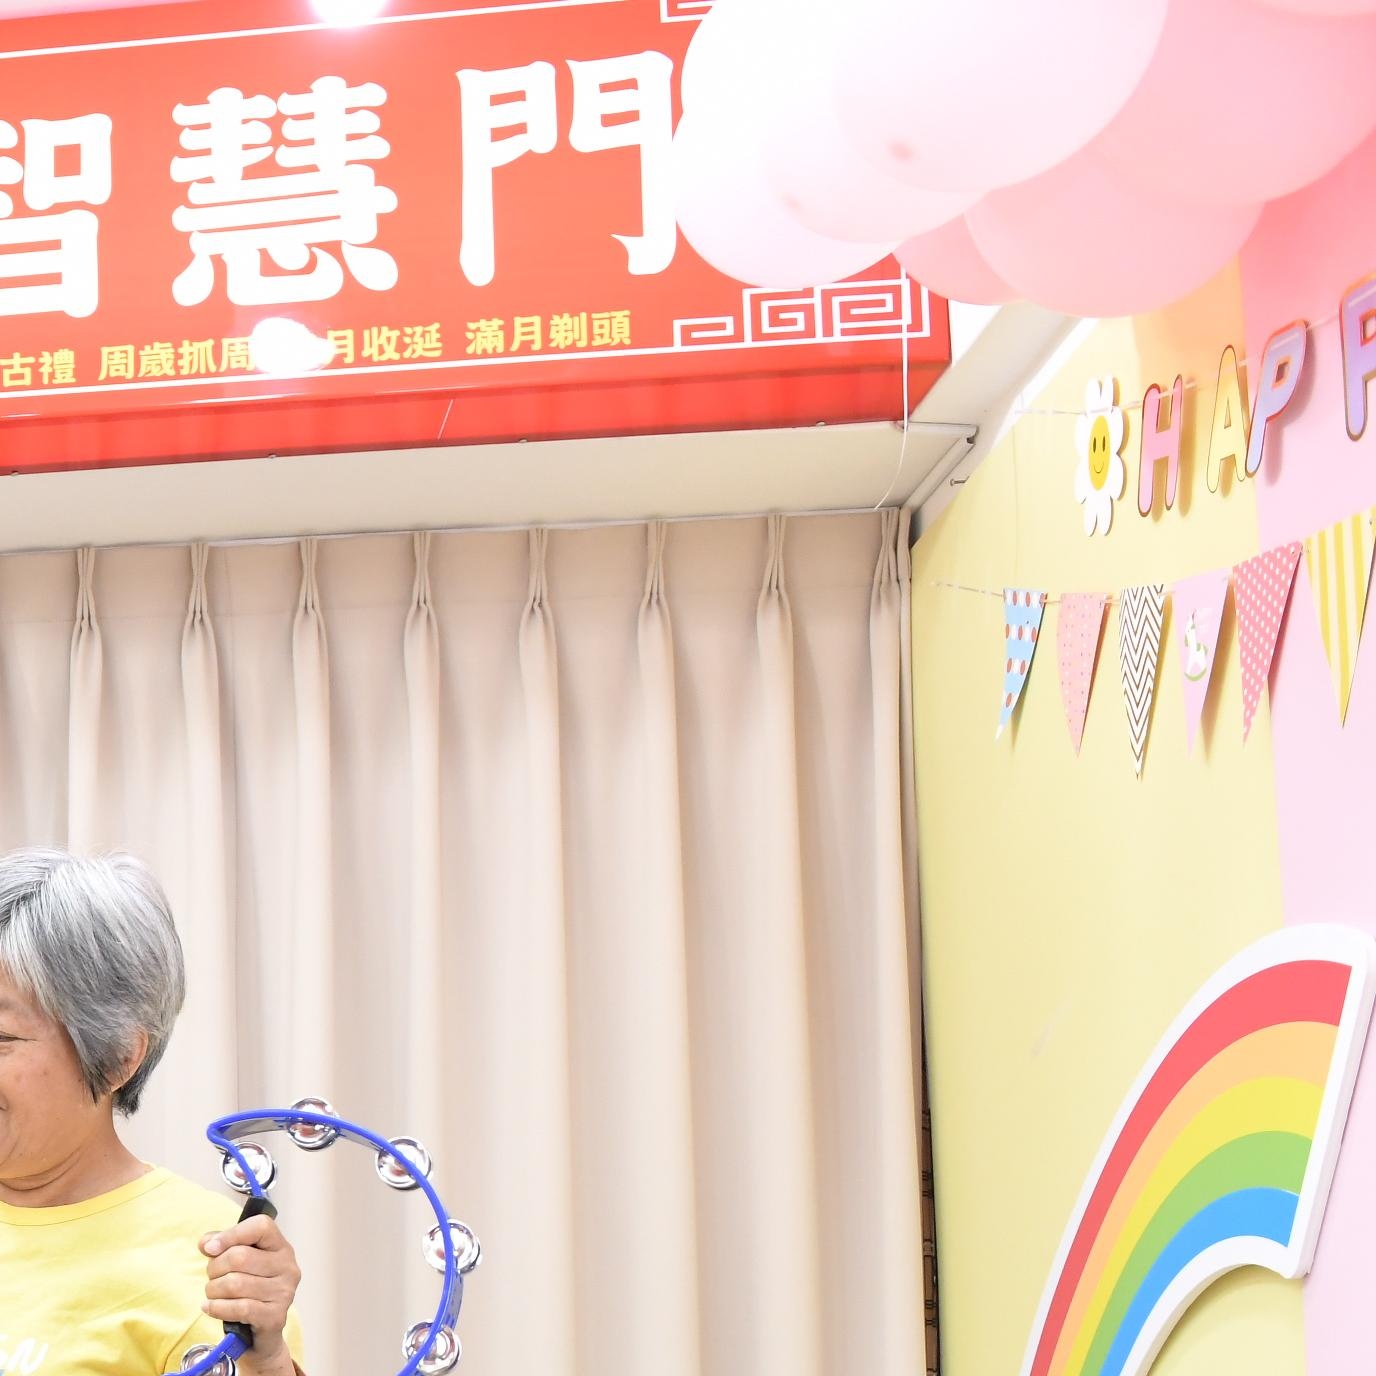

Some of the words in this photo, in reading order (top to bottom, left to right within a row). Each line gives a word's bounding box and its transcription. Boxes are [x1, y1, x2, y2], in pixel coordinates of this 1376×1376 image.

[98, 336, 257, 382] 周歲抓周
[320, 321, 443, 364] 月收涎
[465, 309, 632, 355] 滿月剃頭
